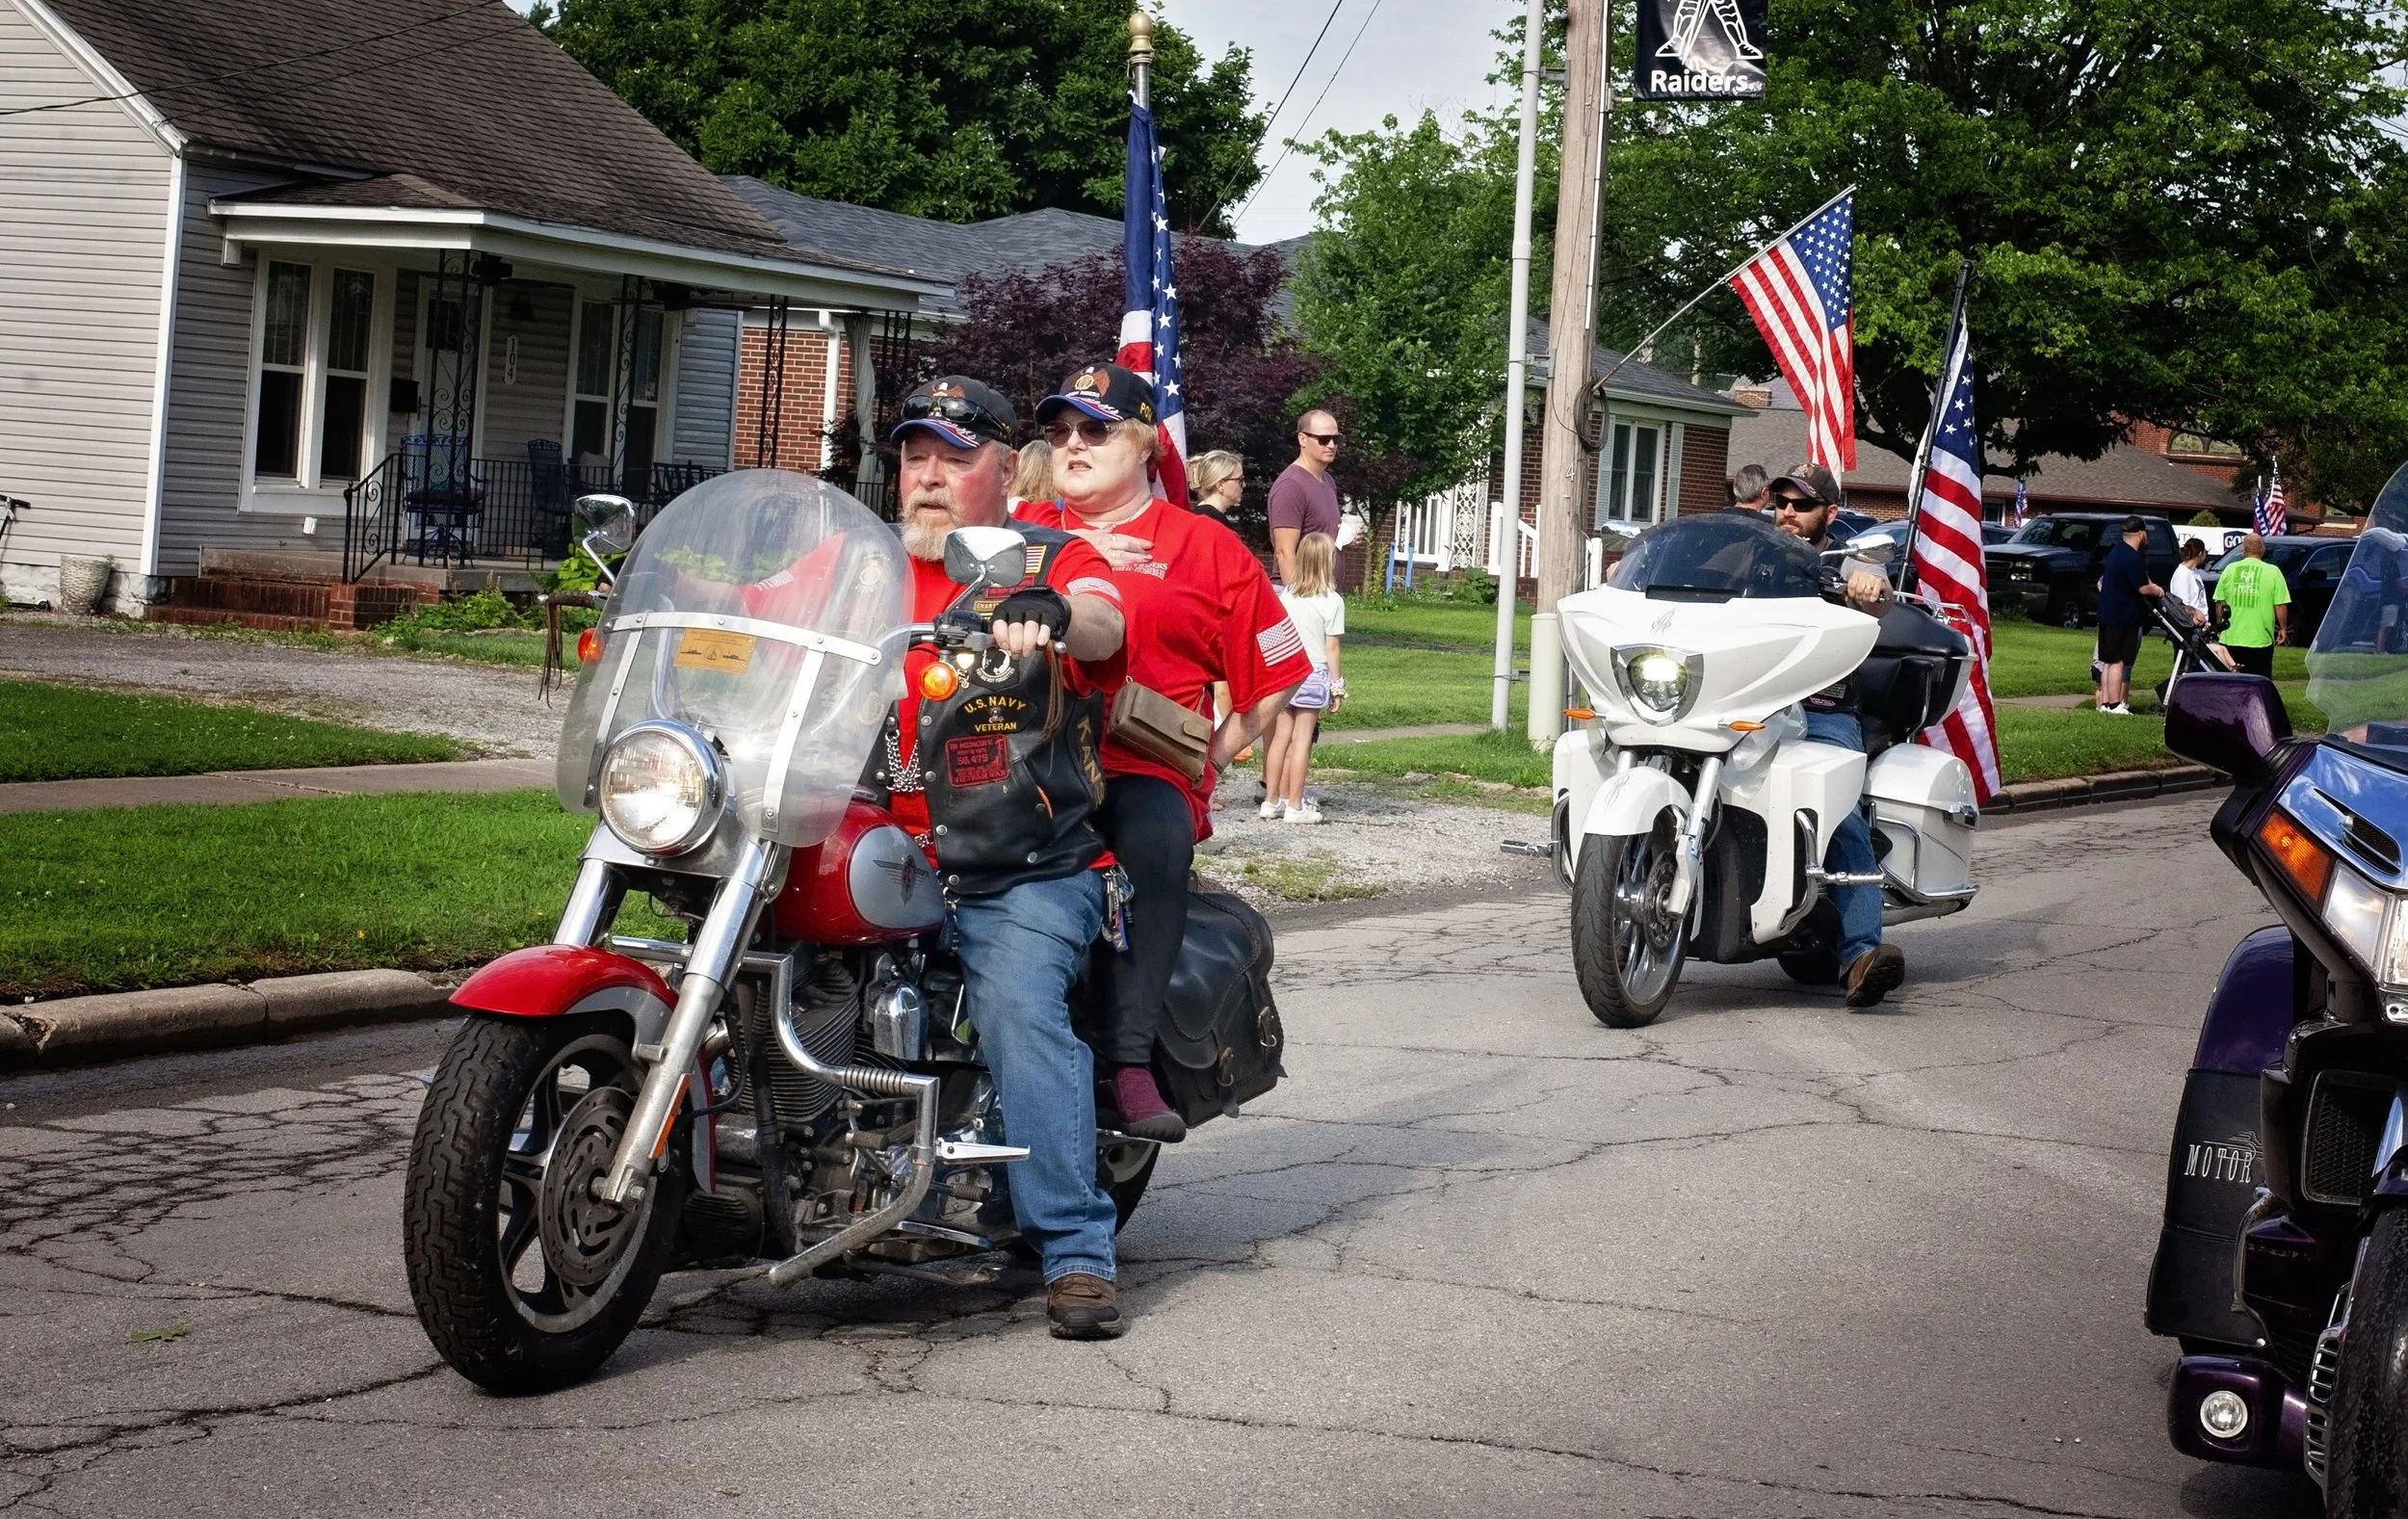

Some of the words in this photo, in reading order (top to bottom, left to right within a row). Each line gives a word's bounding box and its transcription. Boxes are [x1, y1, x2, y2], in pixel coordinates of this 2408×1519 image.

[1650, 68, 1748, 92] Raiders
[1565, 461, 1576, 482] 4
[964, 698, 987, 714] U.S.
[988, 695, 1026, 711] NAVY
[975, 721, 1017, 733] VETERAN
[2184, 1144, 2251, 1183] MOTOR
